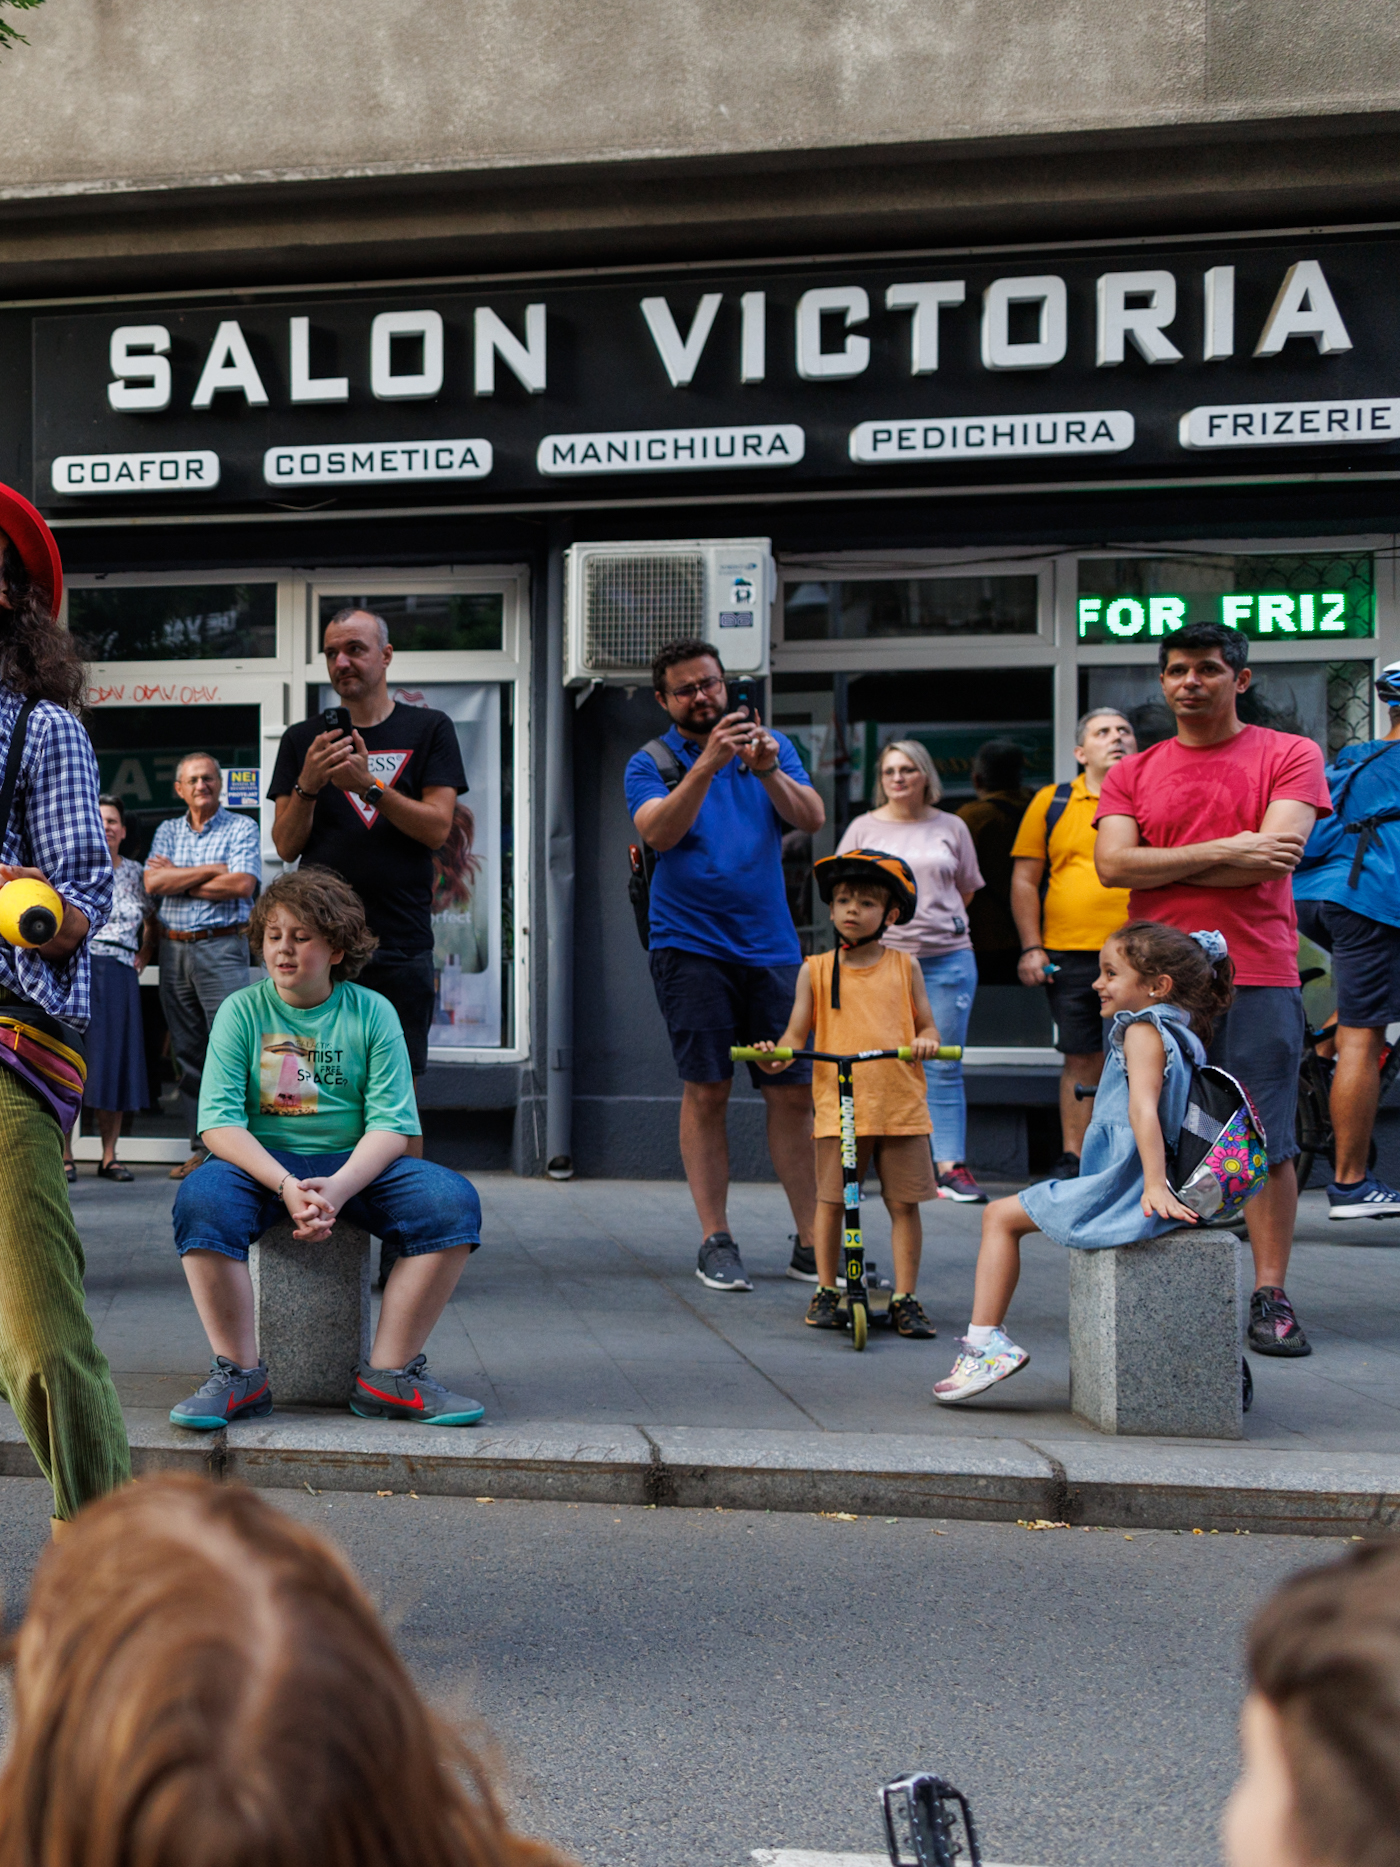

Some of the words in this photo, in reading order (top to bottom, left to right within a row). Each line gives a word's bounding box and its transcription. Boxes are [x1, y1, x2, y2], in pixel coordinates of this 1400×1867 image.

[107, 302, 548, 412] SALON
[640, 260, 1355, 388] VICTORIA
[872, 419, 1115, 452] PEDICHIURA
[1208, 406, 1392, 438] FRIZERIE
[276, 447, 480, 476] COSMETICA
[553, 433, 789, 465] MANICHIURA
[67, 459, 204, 484] COAFOR
[1078, 596, 1186, 637] FOR
[1222, 593, 1346, 633] FRIZ
[368, 756, 397, 773] ESS
[308, 1050, 343, 1063] MIST
[841, 1095, 856, 1169] DOMINATOR
